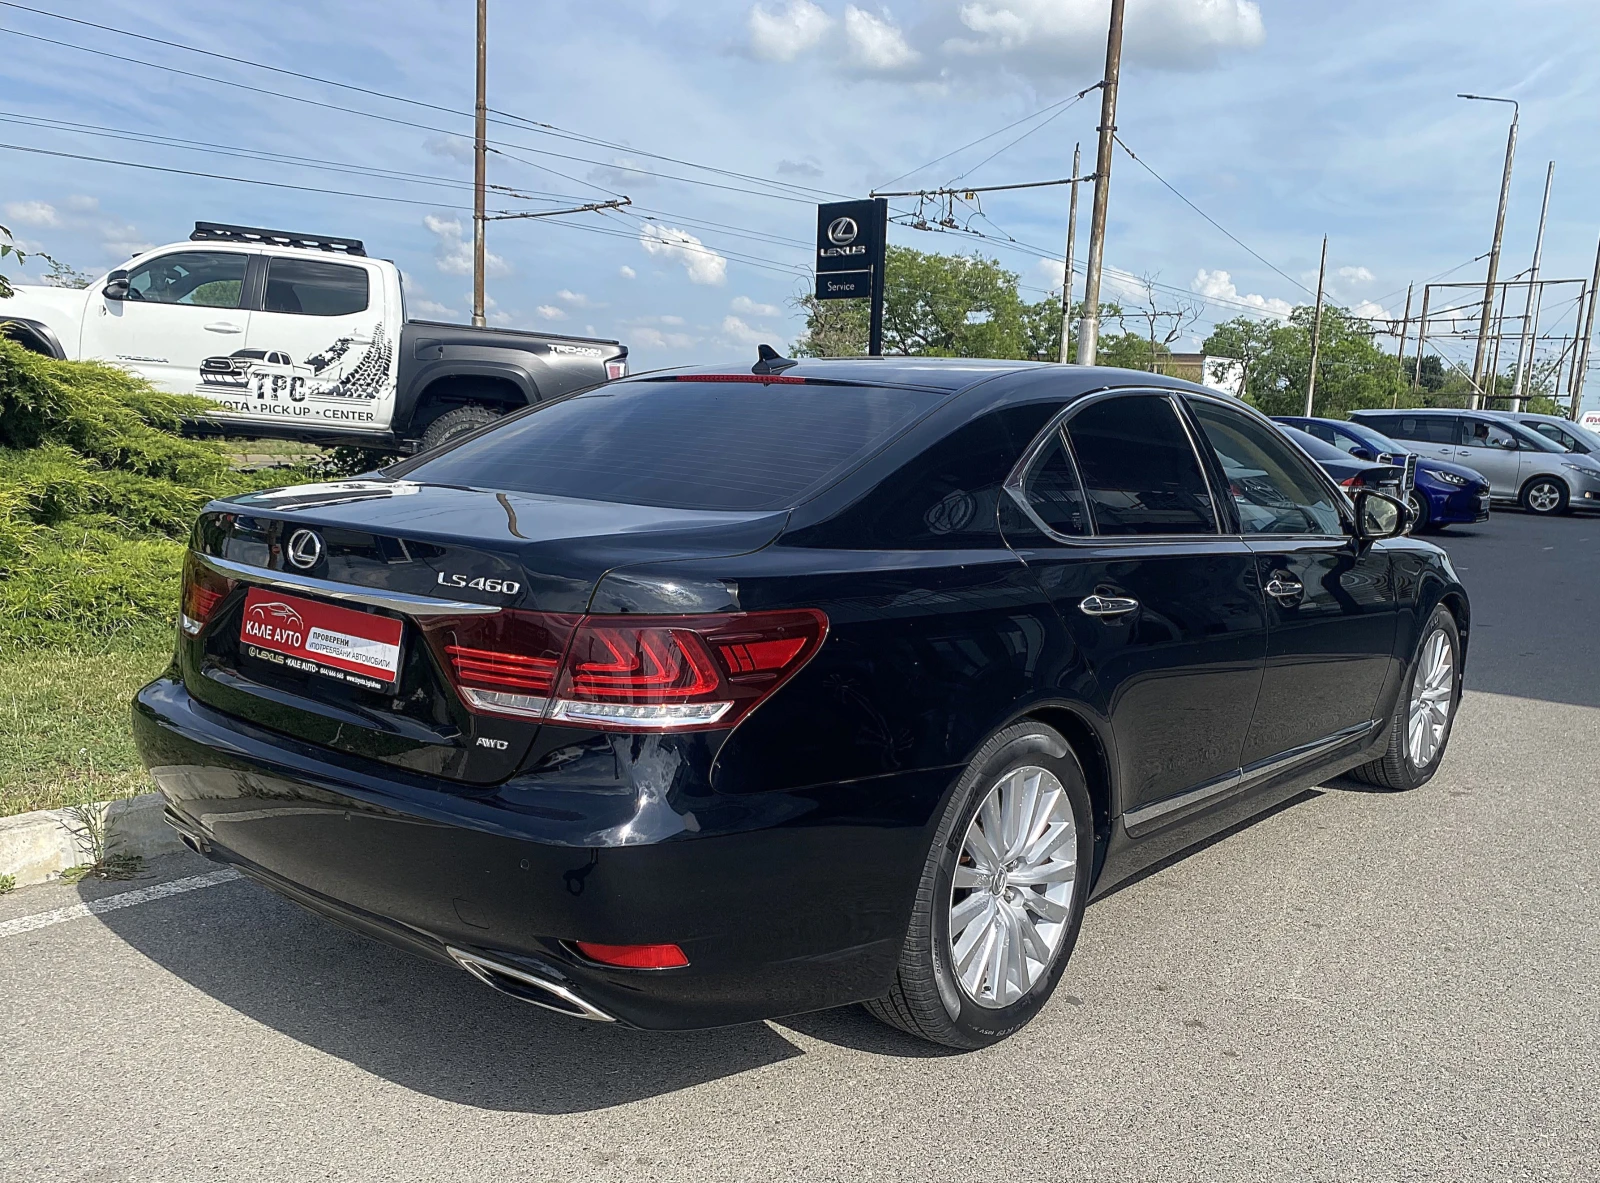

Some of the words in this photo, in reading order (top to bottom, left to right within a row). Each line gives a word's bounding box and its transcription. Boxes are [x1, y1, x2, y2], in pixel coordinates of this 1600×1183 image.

[820, 245, 866, 257] LEXUS
[827, 281, 855, 291] Service
[252, 372, 306, 402] TPC
[260, 403, 291, 415] PICK
[293, 406, 311, 416] UP
[323, 408, 374, 421] CENTER
[245, 620, 273, 640] КАЛЕ
[273, 627, 302, 647] АУТО
[312, 631, 350, 647] ПРОВЕРЕНИ
[256, 649, 285, 665] LEXUS
[351, 652, 391, 669] АВТОМОБИЛИ
[475, 737, 509, 750] AWD
